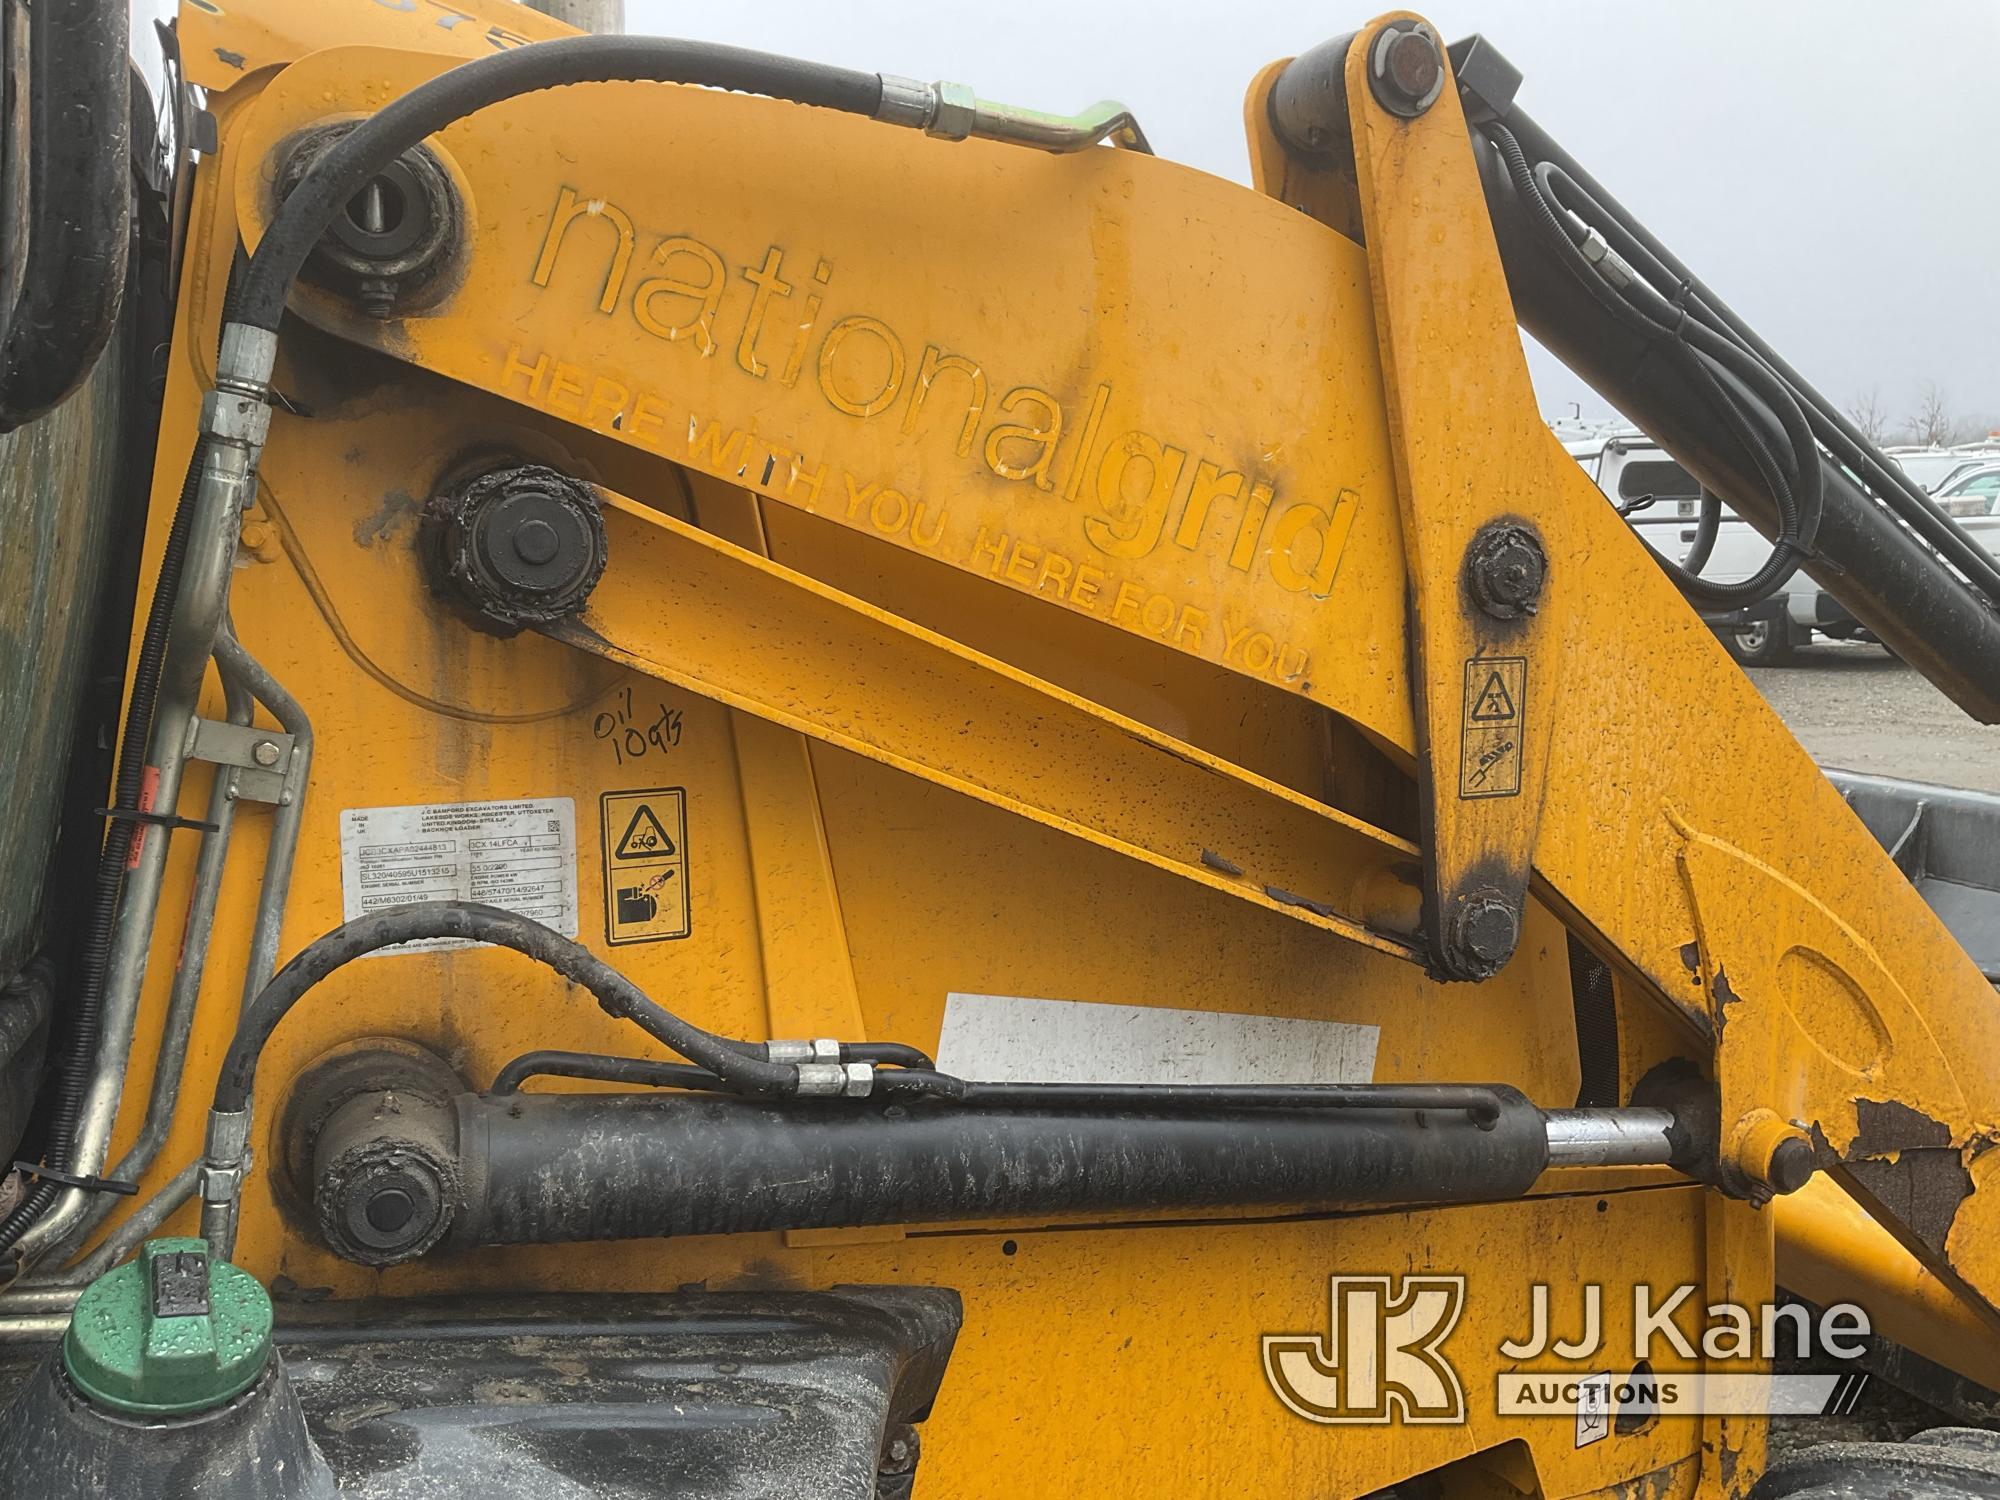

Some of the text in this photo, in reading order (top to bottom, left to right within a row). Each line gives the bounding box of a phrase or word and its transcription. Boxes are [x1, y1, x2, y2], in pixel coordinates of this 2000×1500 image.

[531, 186, 1360, 599] nationalgrid
[500, 342, 669, 446] HERE
[686, 418, 830, 512] WITH
[970, 526, 1108, 609] HERE
[1111, 579, 1211, 651] FOR
[421, 826, 453, 834] BACKHOE
[471, 841, 487, 849] 3CX
